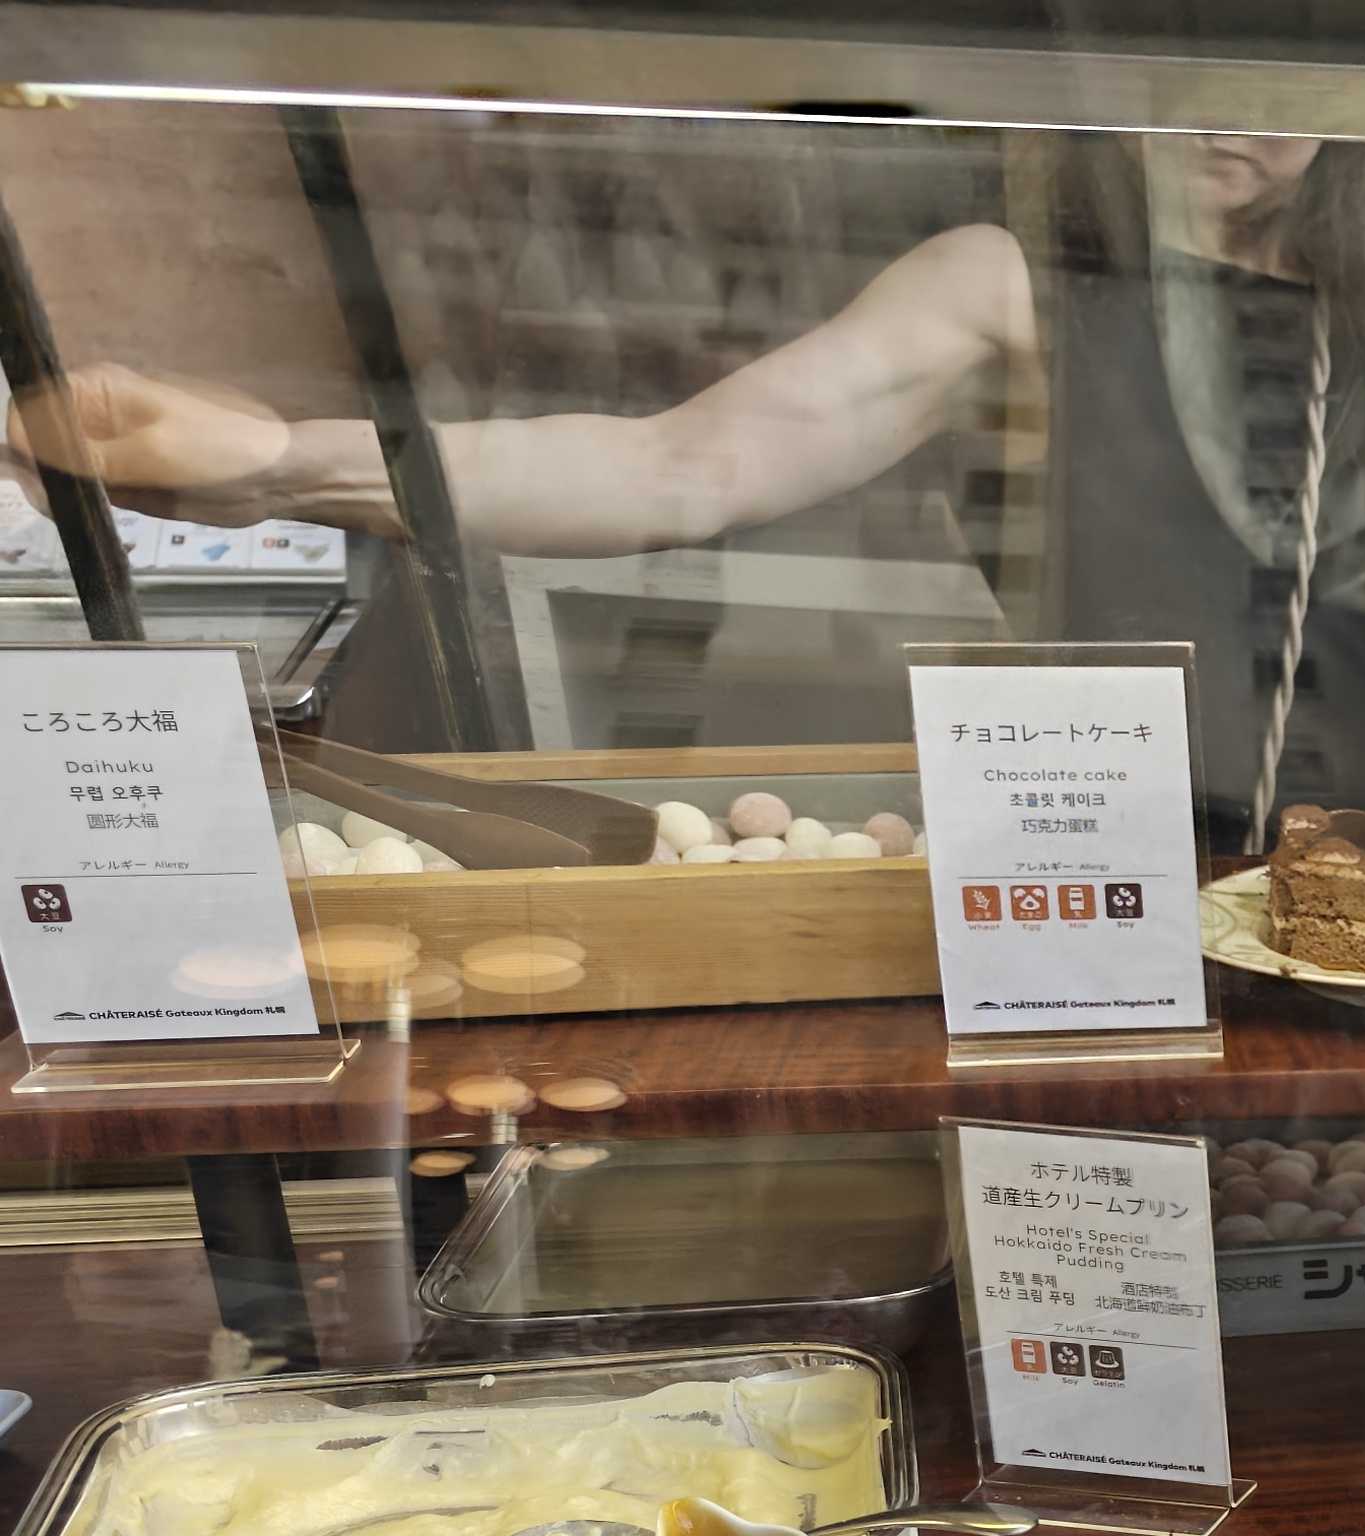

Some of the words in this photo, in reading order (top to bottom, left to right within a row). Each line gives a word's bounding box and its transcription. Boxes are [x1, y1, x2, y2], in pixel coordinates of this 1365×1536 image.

[22, 709, 180, 733] ころころ大福
[950, 723, 1153, 743] チョコレートケーキ
[65, 759, 154, 774] Daihuku
[983, 769, 1078, 782] Chocolate
[1084, 769, 1128, 782] cake
[112, 785, 163, 801] 오후쿠
[1061, 792, 1107, 807] 케이크
[78, 860, 147, 871] アレルギー
[42, 925, 64, 934] Soy
[214, 1006, 264, 1018] Kingdom
[1030, 1161, 1135, 1188] ホテル特製
[981, 1184, 1189, 1219] 道産生クリームプリン
[1026, 1223, 1082, 1240] Hotel's
[1088, 1228, 1151, 1247] Special
[993, 1234, 1073, 1253] Hokkaido
[1078, 1242, 1124, 1257] Fresh
[1129, 1246, 1188, 1263] Cream
[1056, 1253, 1126, 1274] Pudding
[999, 1270, 1026, 1287] 호텔
[985, 1285, 1012, 1301] 도산
[1016, 1287, 1043, 1304] 크림
